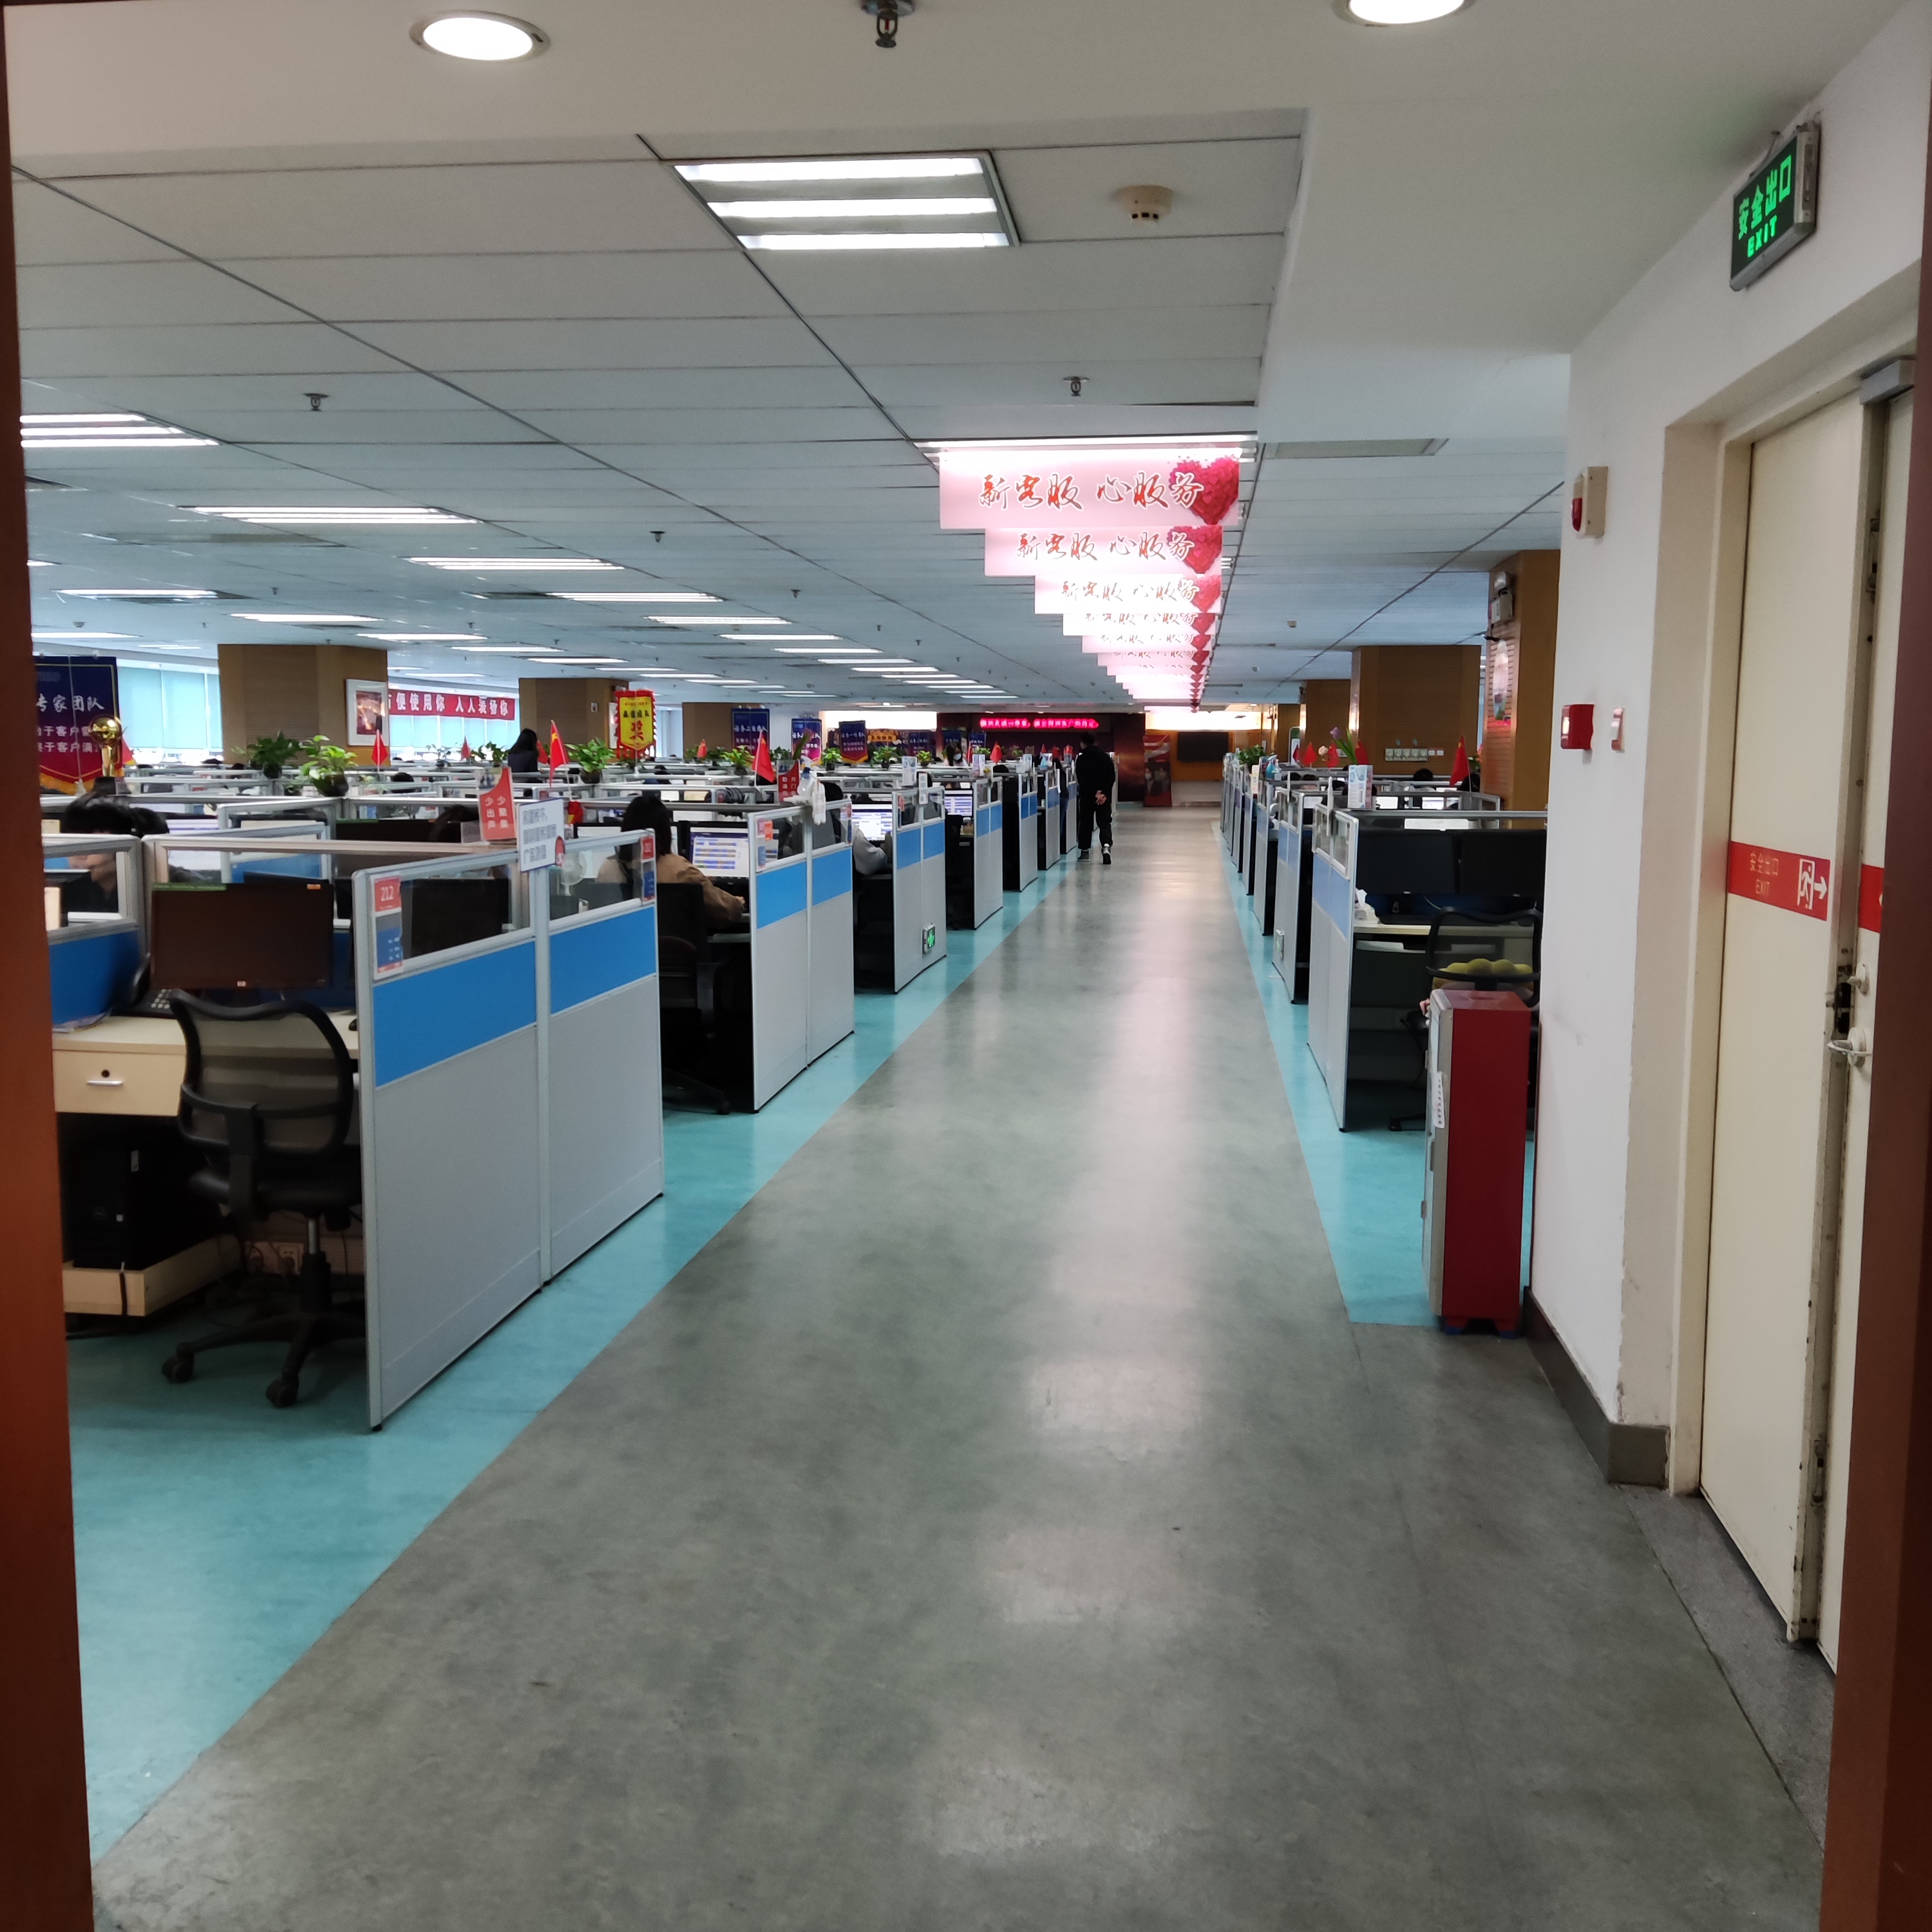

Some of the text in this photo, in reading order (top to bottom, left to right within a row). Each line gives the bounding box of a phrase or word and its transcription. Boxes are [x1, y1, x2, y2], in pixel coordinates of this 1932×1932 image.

[1738, 155, 1792, 240] 安全出口
[1747, 214, 1777, 258] EXIT
[36, 692, 104, 712] 专家团队
